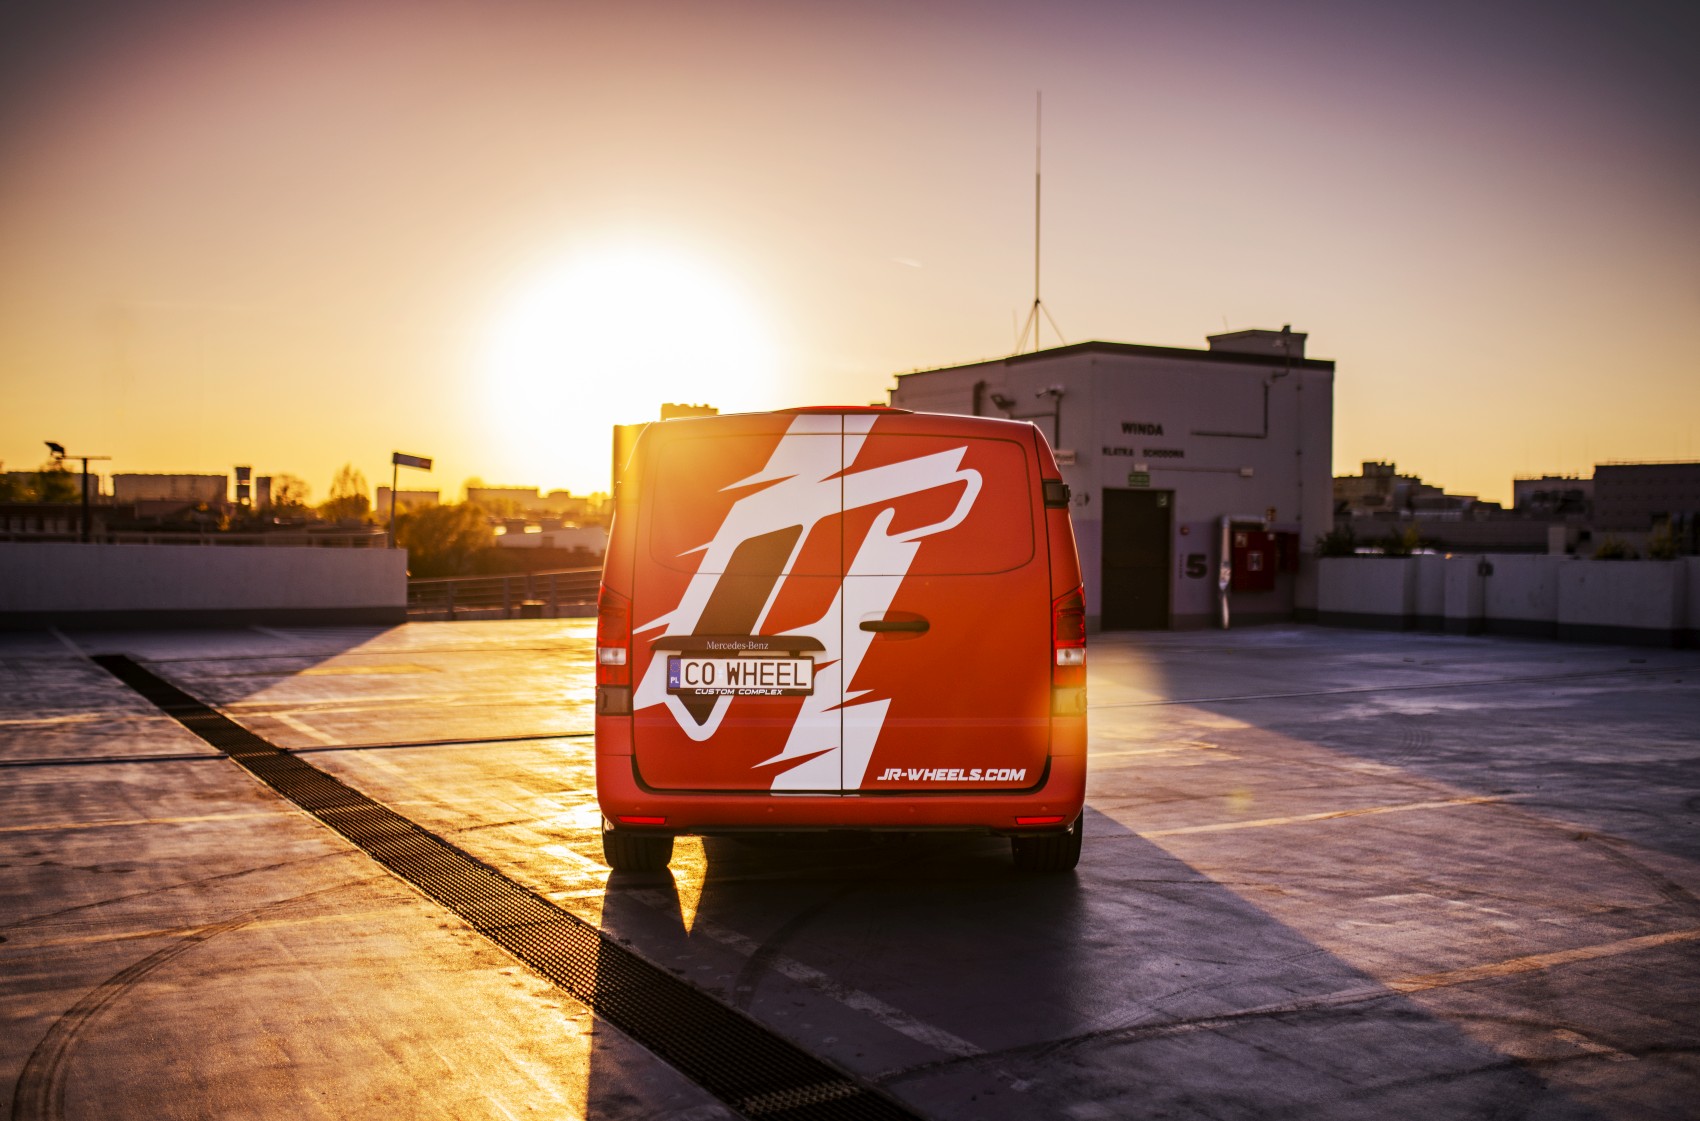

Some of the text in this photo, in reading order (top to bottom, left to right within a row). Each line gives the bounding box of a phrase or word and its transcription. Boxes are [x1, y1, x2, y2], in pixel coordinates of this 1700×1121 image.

[1121, 422, 1164, 436] WINDA
[1186, 553, 1208, 579] 5
[706, 641, 769, 650] Mercedes-Benz
[726, 662, 807, 686] WHEEL
[738, 688, 783, 696] COMPLEX
[877, 768, 1027, 781] JR-WHEELS.COM
